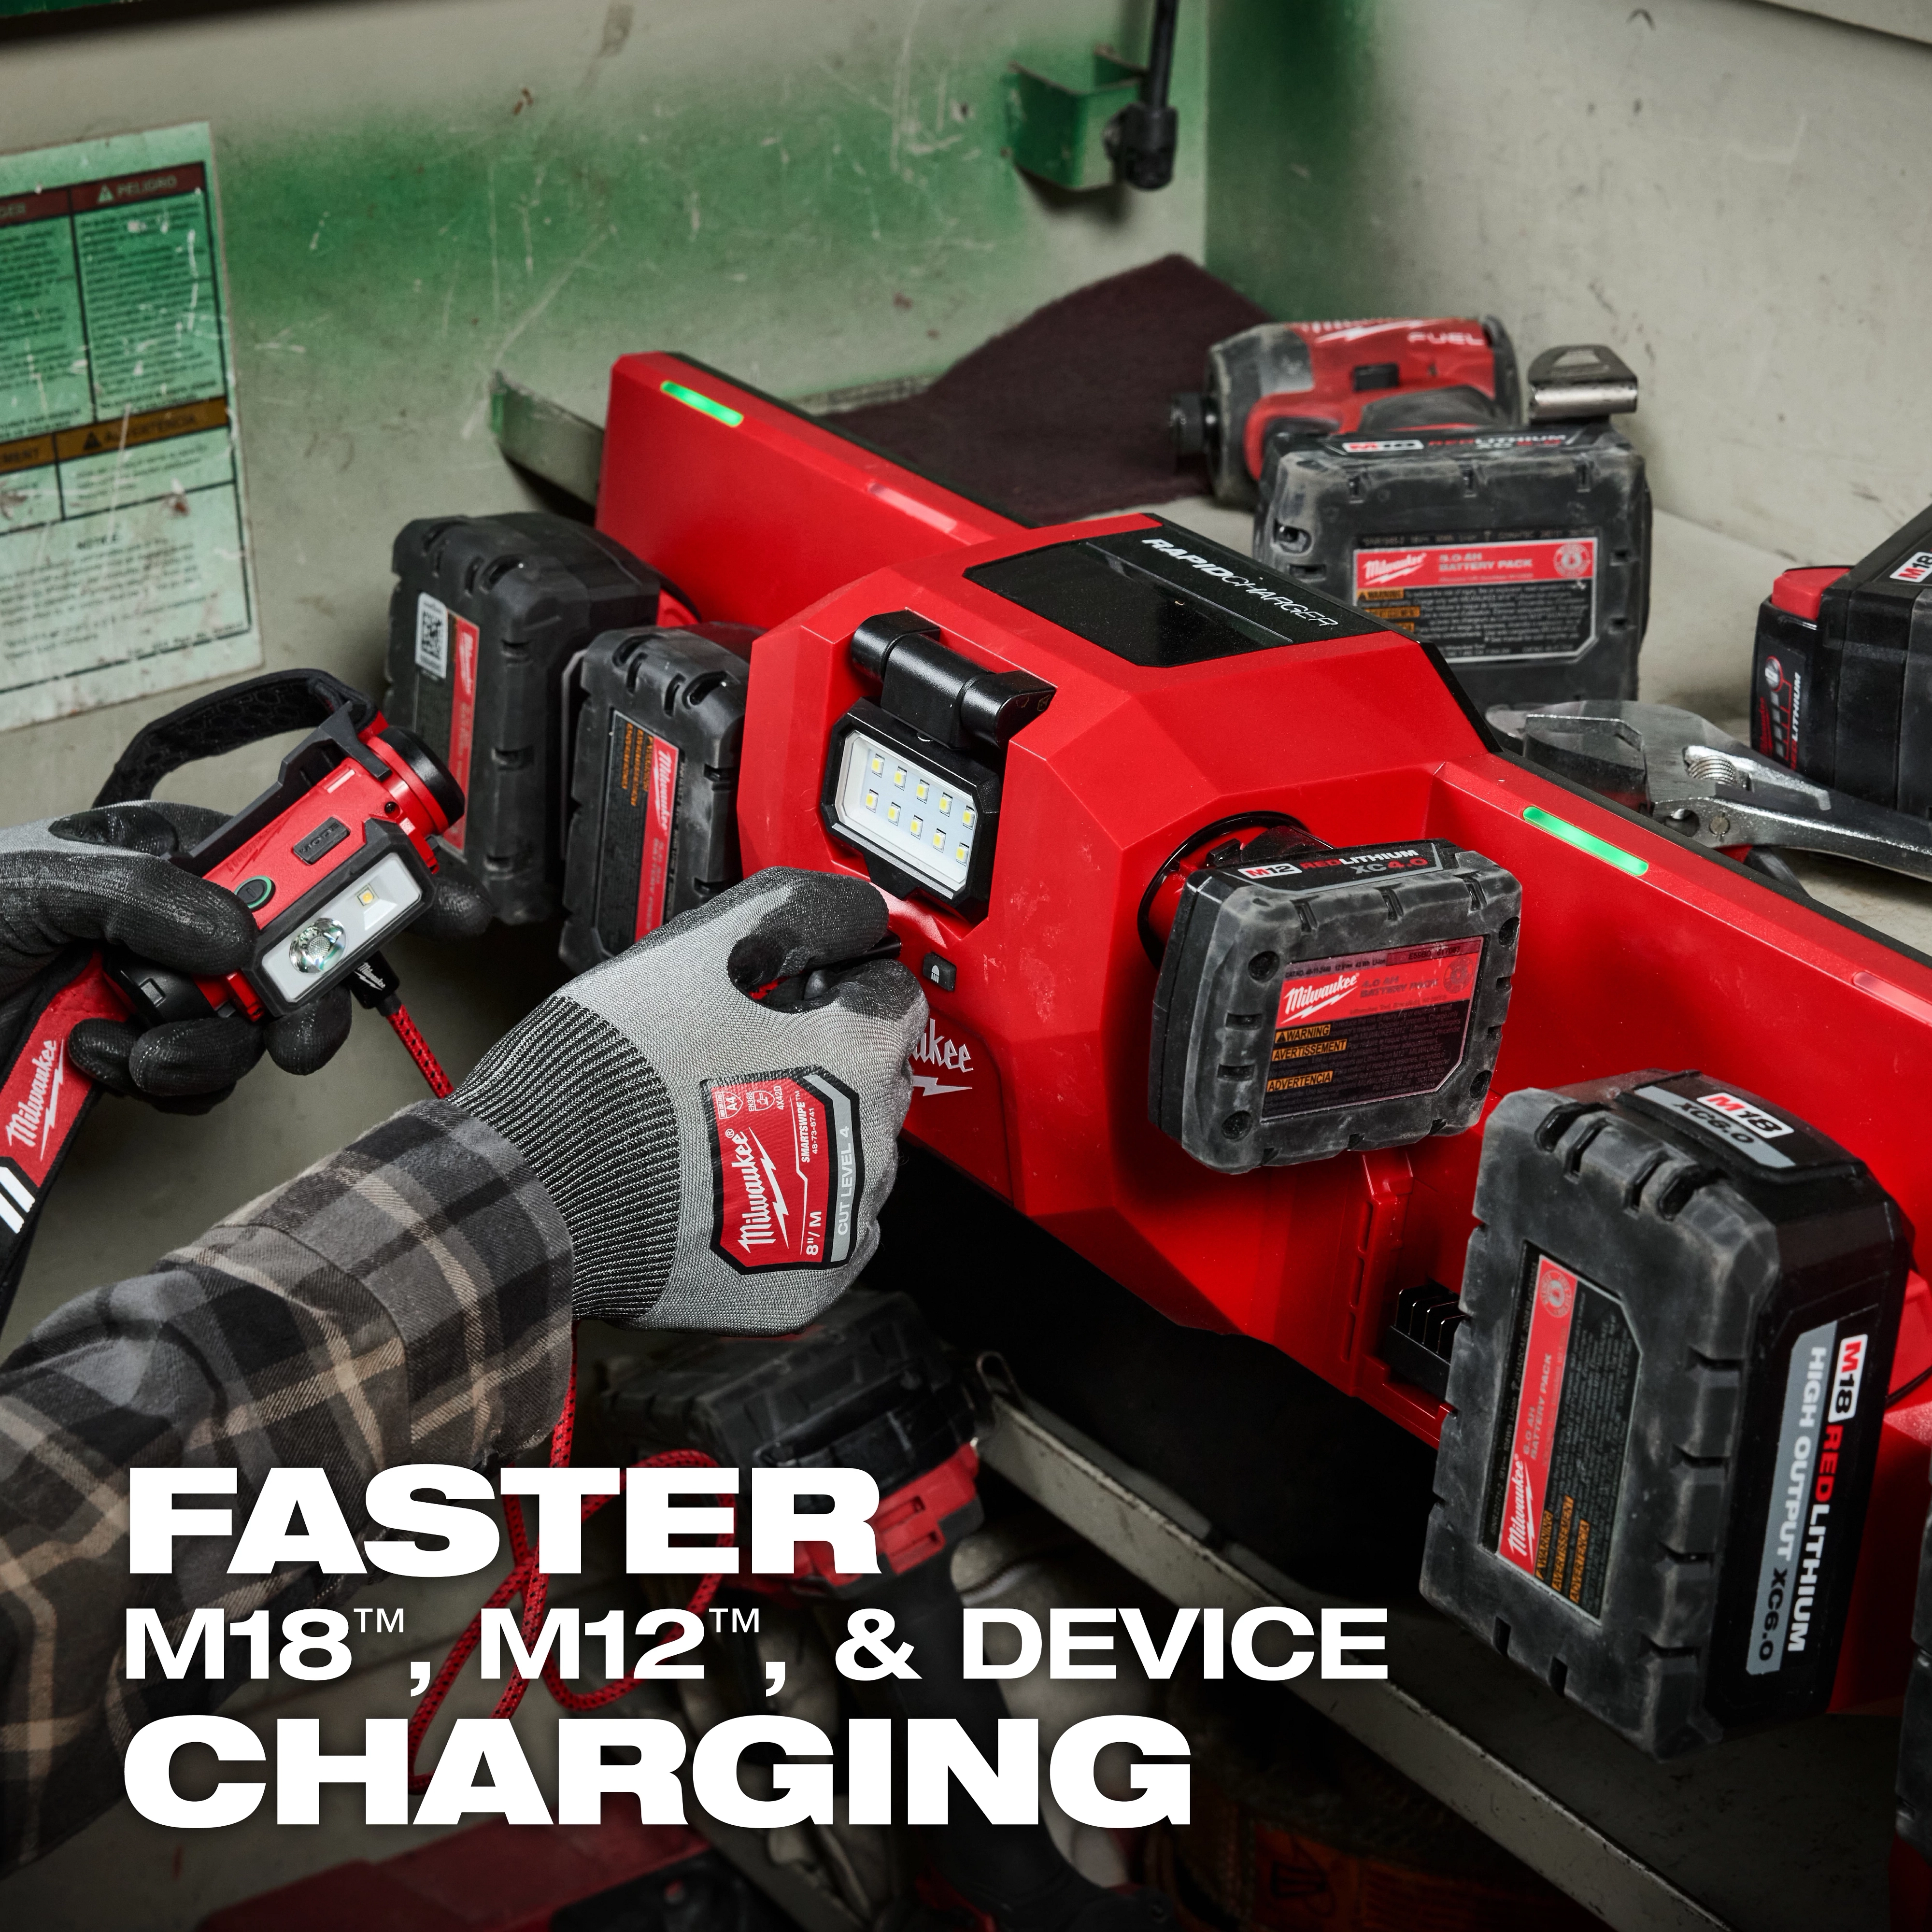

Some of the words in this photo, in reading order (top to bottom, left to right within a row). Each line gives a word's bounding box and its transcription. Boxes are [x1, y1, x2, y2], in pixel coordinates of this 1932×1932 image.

[1407, 332, 1484, 346] FUEL
[1498, 558, 1533, 569] PACK
[1898, 555, 1932, 579] M18
[1245, 866, 1297, 877] M12
[1300, 849, 1420, 870] REDLITHIUM
[1284, 973, 1358, 1015] Milwaukee
[1274, 1040, 1347, 1061] AVERTISSEMENT
[1287, 1025, 1330, 1039] WARNING
[6, 1040, 57, 1147] Milwaukee
[774, 1085, 784, 1110] 4X42D
[1268, 1073, 1331, 1092] ADVERTENCIA
[726, 1096, 738, 1111] A4
[746, 1092, 755, 1112] EN388
[1706, 1095, 1783, 1132] M18
[809, 1108, 818, 1154] 48-73-8741
[839, 1125, 850, 1138] 4
[1673, 1102, 1755, 1143] XC6.0
[840, 1142, 853, 1198] LEVEL
[837, 1202, 852, 1236] CUT
[1799, 1347, 1827, 1428] HIGH
[1835, 1340, 1862, 1414] M18
[1530, 1395, 1546, 1460] BATTERY
[1539, 1353, 1552, 1394] PACK
[1507, 1458, 1528, 1557] Milwaukee
[1776, 1435, 1812, 1562] OUTPUT
[1788, 1424, 1844, 1652] REDLITHIUM
[1759, 1567, 1789, 1661] XC6.0
